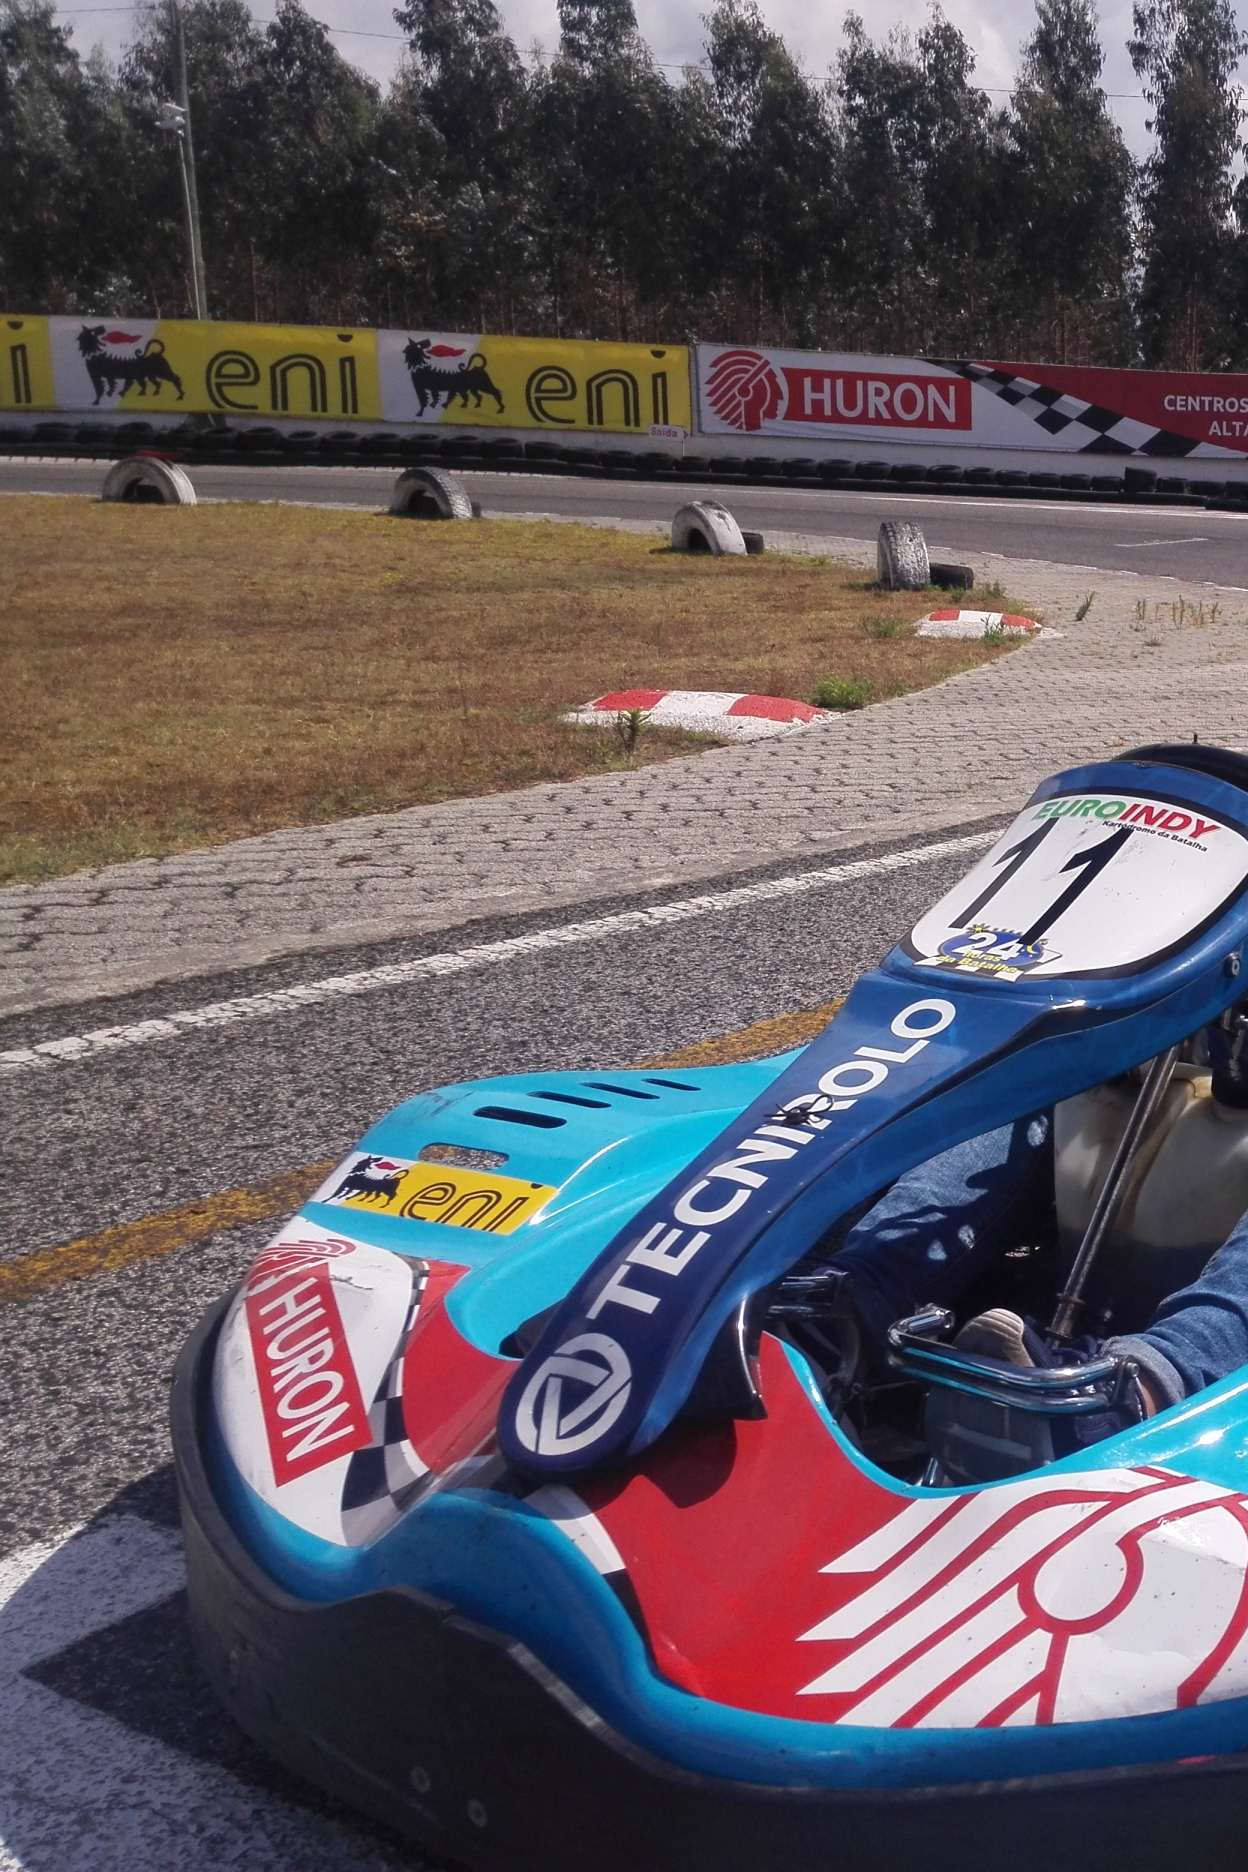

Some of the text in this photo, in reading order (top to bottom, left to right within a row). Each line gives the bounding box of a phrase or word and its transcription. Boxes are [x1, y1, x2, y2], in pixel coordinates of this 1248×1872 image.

[205, 334, 358, 414] eni
[525, 350, 668, 427] eni
[803, 376, 957, 423] HURON
[1032, 799, 1222, 838] EUROINDY
[1157, 830, 1170, 839] da
[1171, 834, 1208, 852] Batalha
[949, 816, 1135, 945] 11
[952, 932, 1026, 961] 24
[585, 998, 956, 1321] TECNIROLO
[400, 1182, 545, 1234] eni
[258, 1276, 354, 1464] HURON
